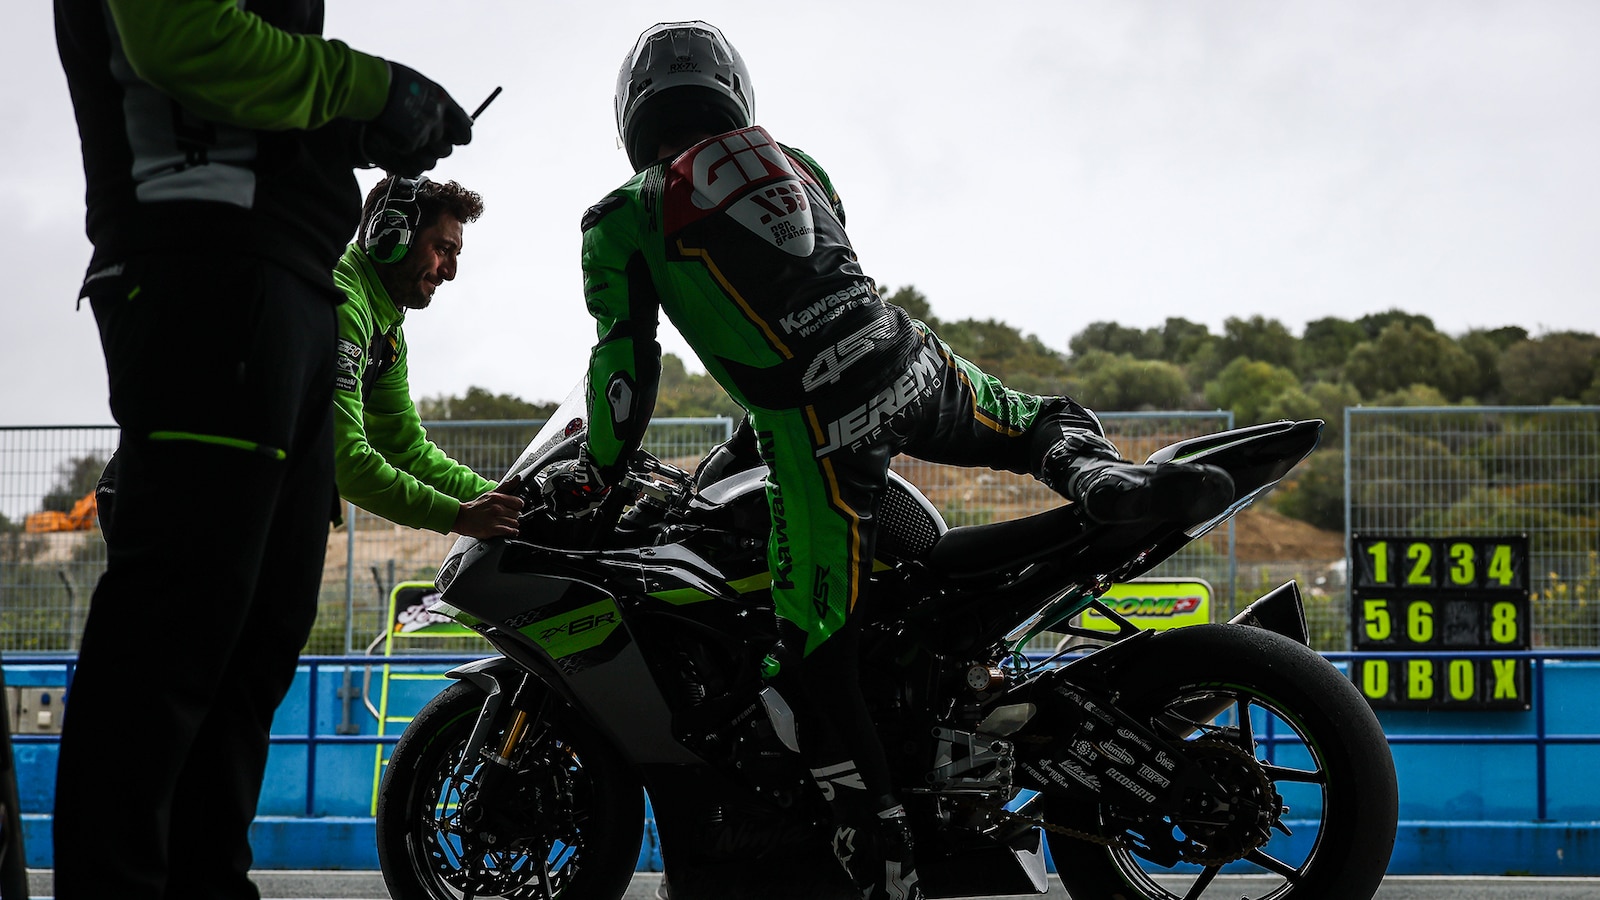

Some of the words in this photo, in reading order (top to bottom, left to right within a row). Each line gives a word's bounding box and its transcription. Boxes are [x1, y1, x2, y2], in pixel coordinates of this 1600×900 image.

[770, 220, 791, 233] non
[773, 224, 796, 239] solo
[775, 226, 814, 247] grandin
[778, 276, 872, 335] Kawasaki
[799, 304, 846, 338] WorldSSP
[846, 295, 871, 313] Team
[816, 337, 944, 458] JEREMY
[851, 407, 907, 454] FIFTY
[913, 377, 942, 407] TWO
[1102, 738, 1133, 765] domino
[1105, 767, 1157, 803] ACCOSSATO
